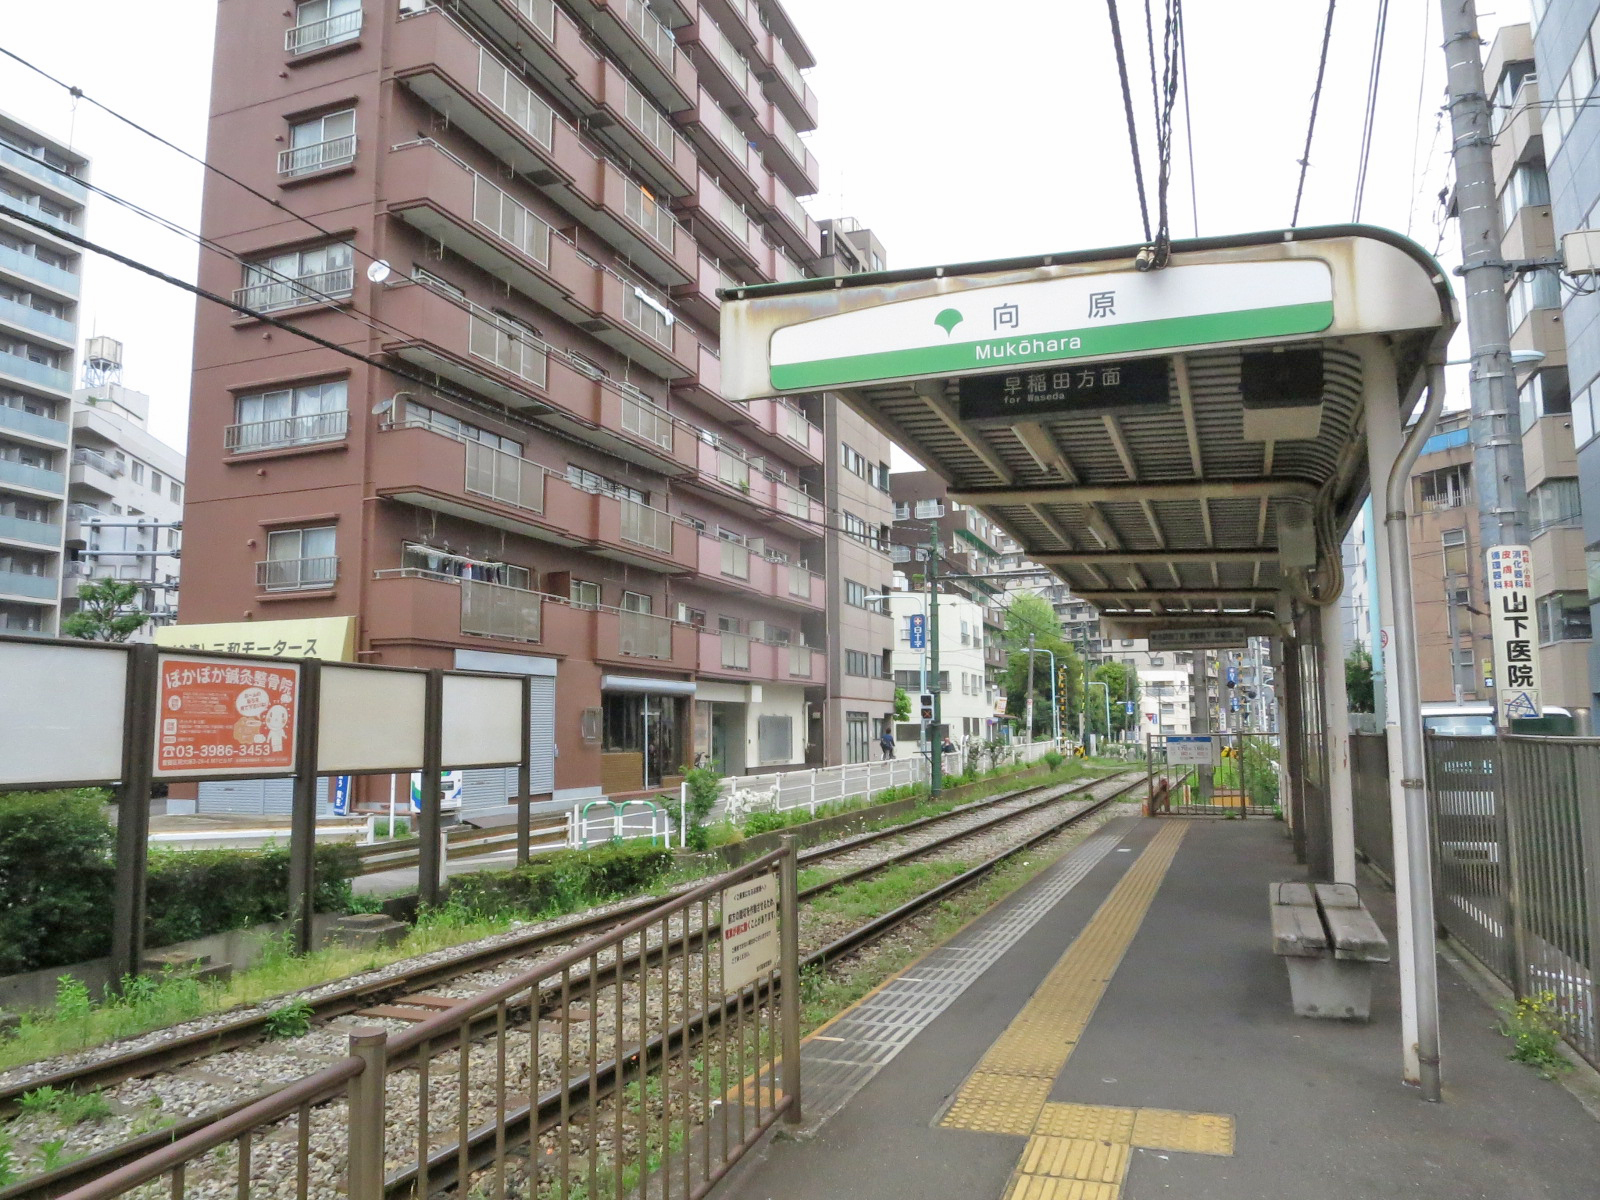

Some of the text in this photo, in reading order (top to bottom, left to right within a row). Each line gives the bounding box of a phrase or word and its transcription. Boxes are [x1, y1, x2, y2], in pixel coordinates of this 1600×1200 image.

[975, 336, 1082, 360] Mukōhara
[1004, 367, 1121, 395] 早稲田方面
[1004, 392, 1065, 404] for Waseda
[1502, 550, 1513, 589] 皮膚科
[1512, 550, 1524, 588] 消化器科
[913, 626, 923, 648] 白十字
[1503, 591, 1533, 688] 山下医院
[166, 666, 293, 695] ぽかぽか鍼灸整骨院
